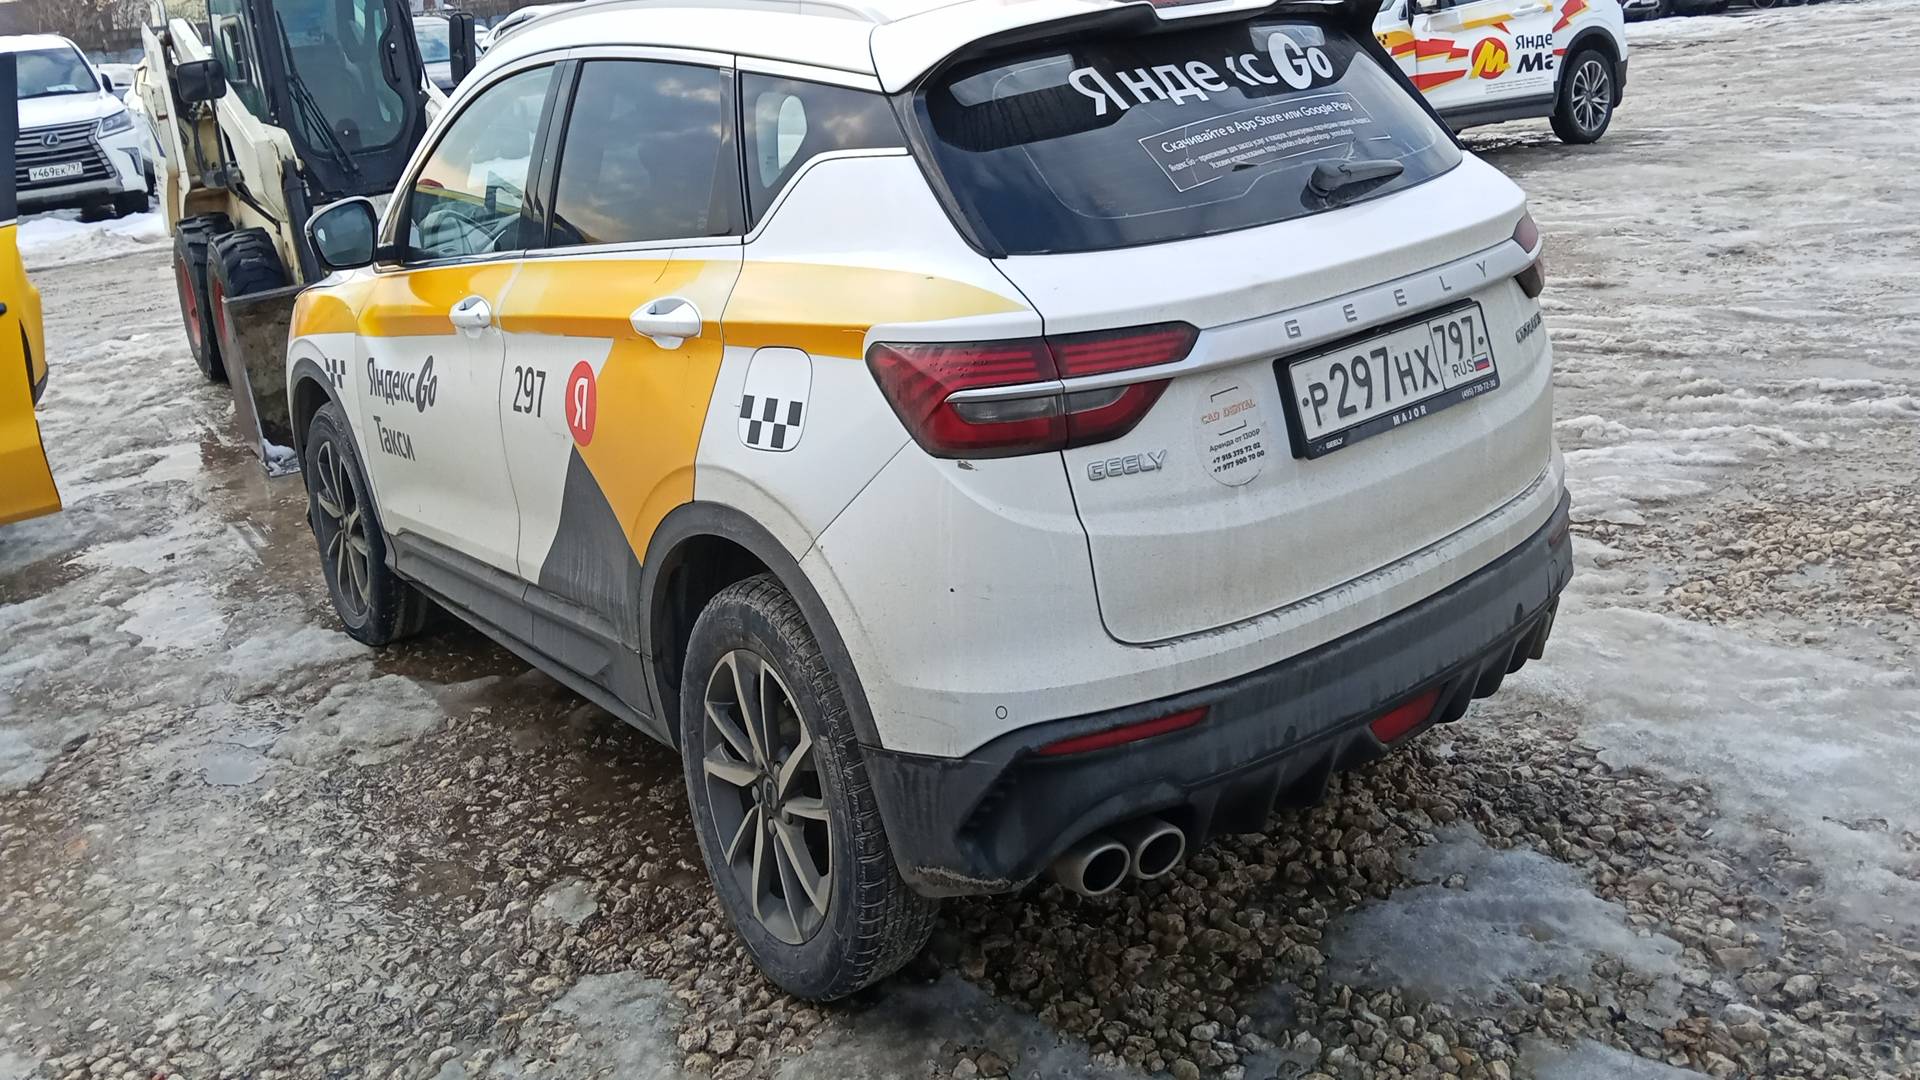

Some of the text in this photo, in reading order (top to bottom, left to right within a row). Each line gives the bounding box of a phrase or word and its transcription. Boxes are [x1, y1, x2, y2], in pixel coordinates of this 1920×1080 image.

[1267, 32, 1334, 90] Go
[1161, 101, 1353, 153] Скачивайте в App Store или Google Play
[1284, 260, 1488, 339] GEELY
[1432, 315, 1476, 367] 797
[367, 354, 437, 413] Яндекс Go
[1452, 359, 1475, 379] RUS
[513, 365, 546, 418] 297
[1392, 404, 1428, 426] MAJOR
[373, 415, 416, 462] Такси
[1209, 438, 1234, 453] Аренда
[1234, 435, 1242, 444] от
[1222, 452, 1233, 463] 915
[1232, 447, 1244, 458] 375
[1244, 444, 1253, 452] 72
[1325, 436, 1344, 450] GEELY
[1086, 448, 1167, 482] GEELY
[1223, 461, 1235, 471] 977
[1247, 452, 1256, 461] 70
[1256, 449, 1265, 458] 00
